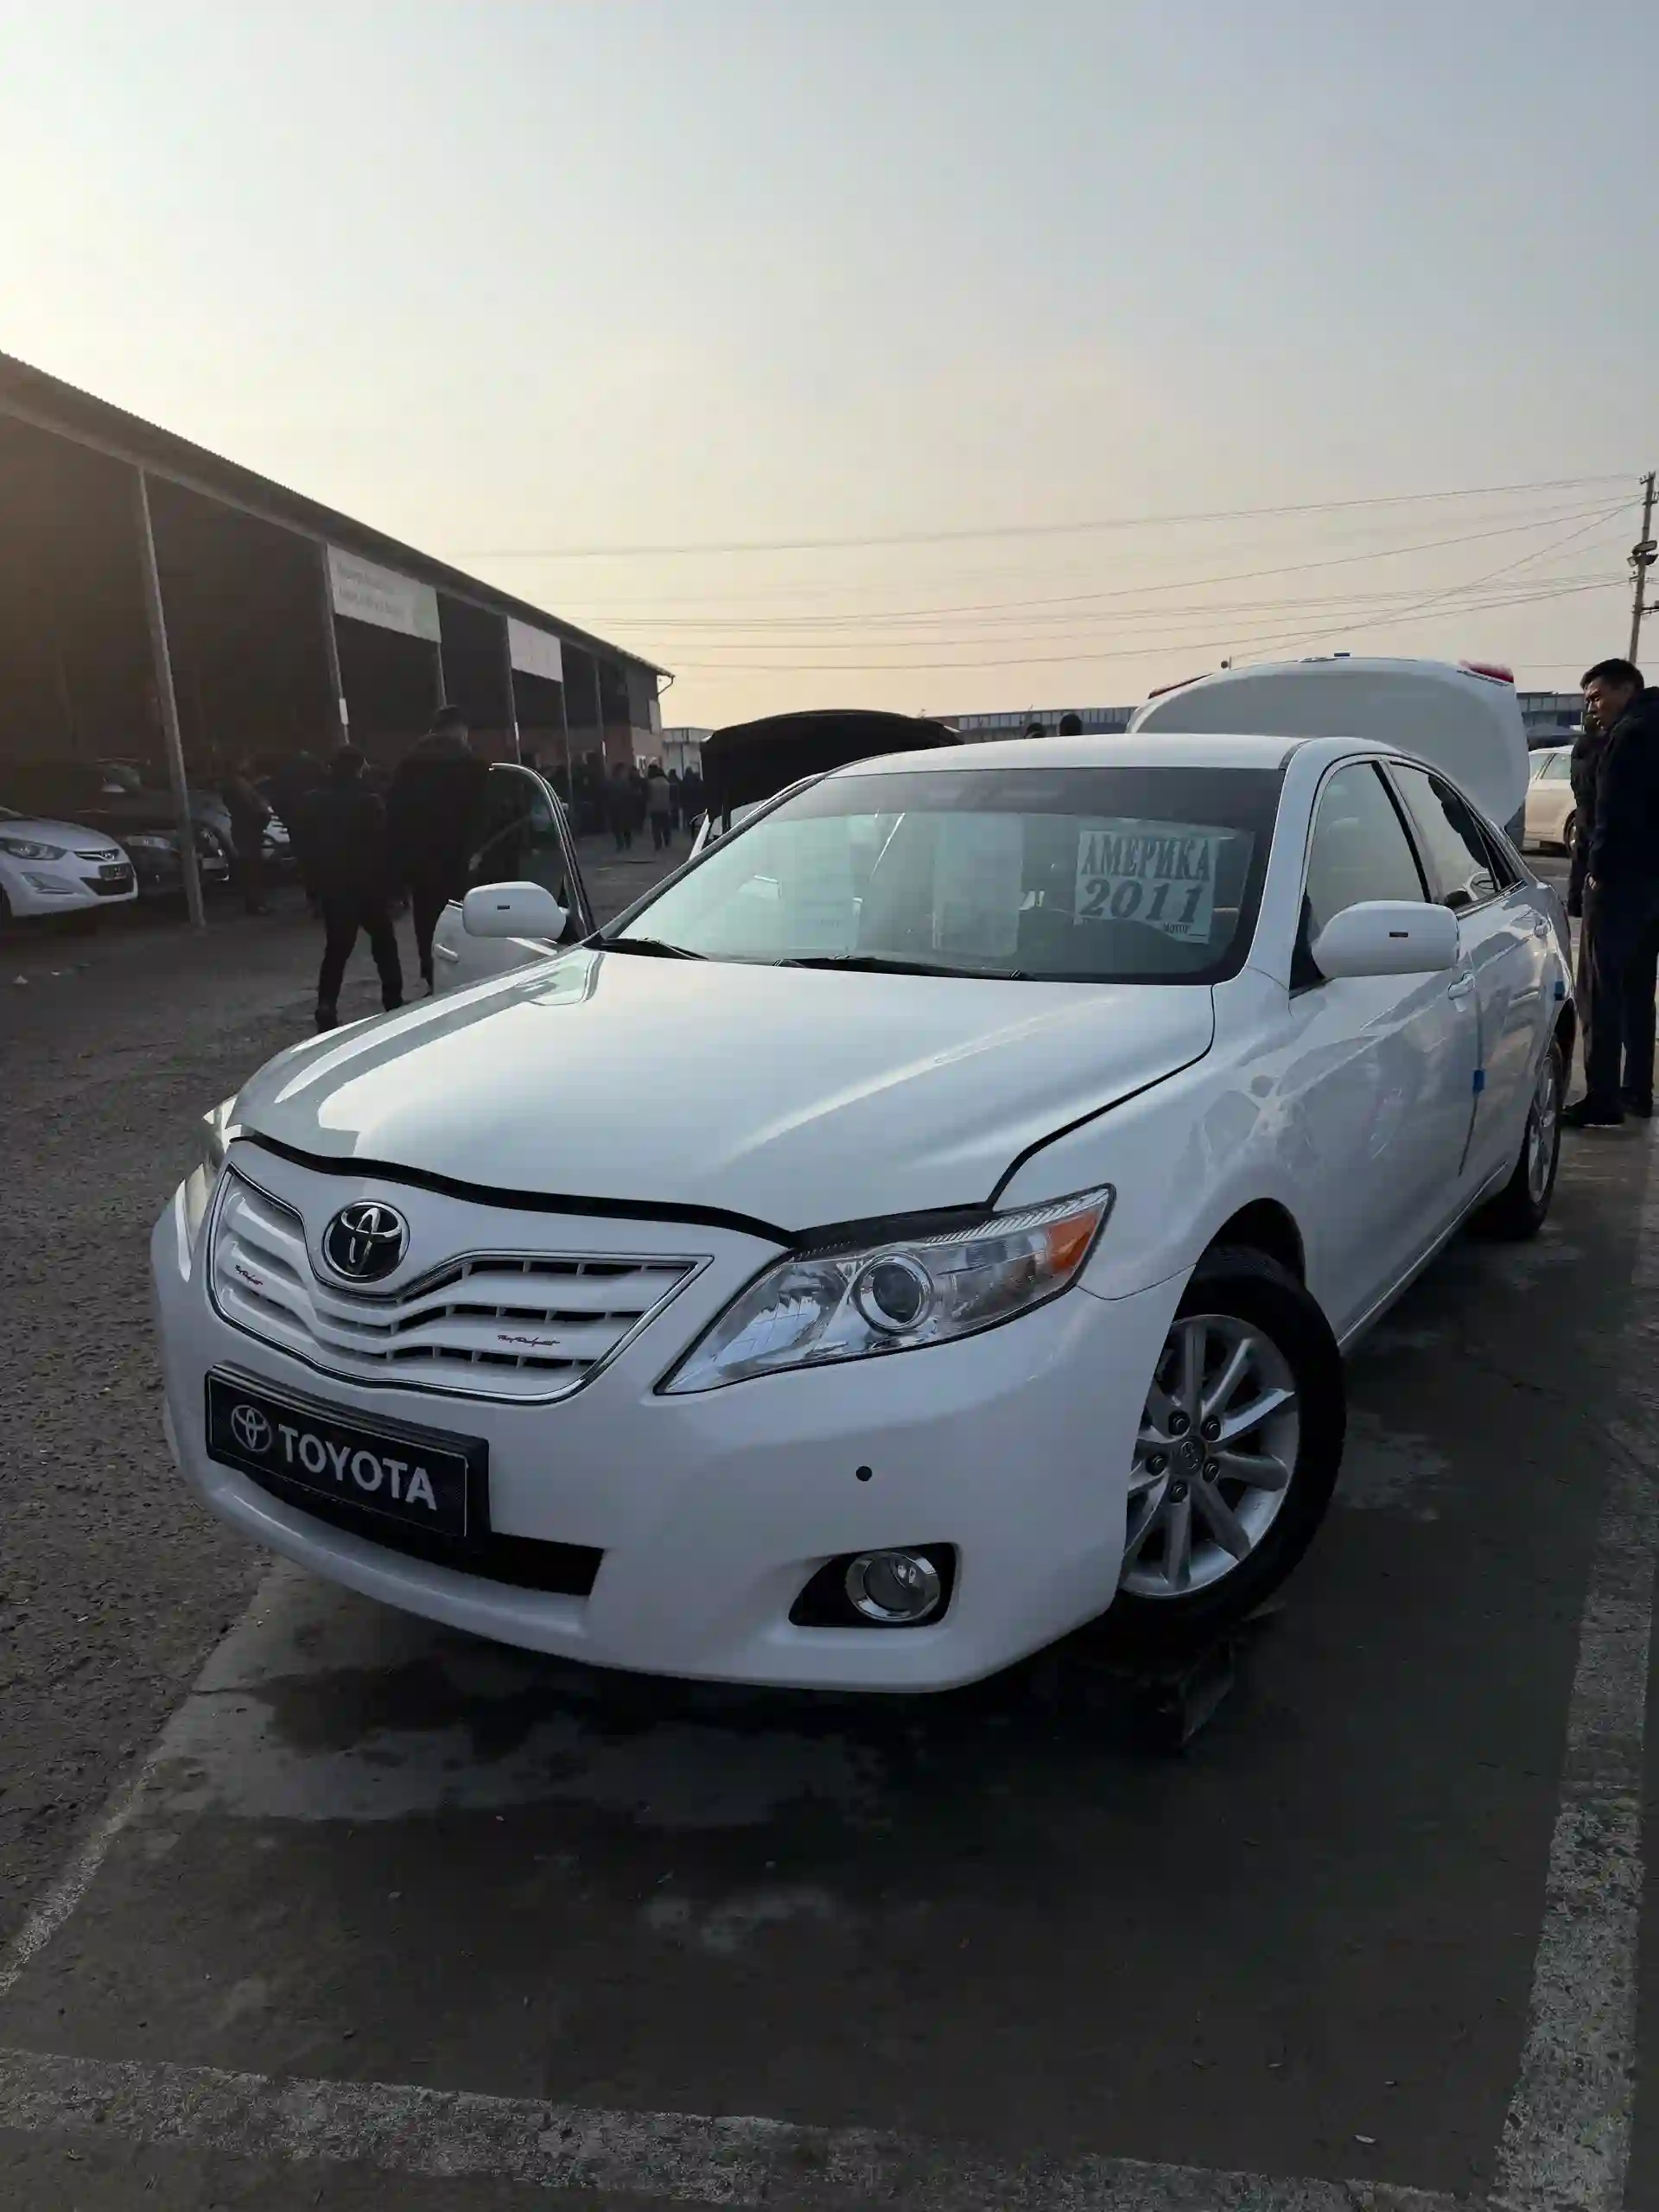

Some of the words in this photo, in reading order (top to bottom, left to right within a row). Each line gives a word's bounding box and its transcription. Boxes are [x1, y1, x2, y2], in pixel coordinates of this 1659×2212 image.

[1080, 835, 1211, 880] АМЕРИКА
[1079, 877, 1205, 923] 2011
[278, 1423, 437, 1510] TOYOTA
